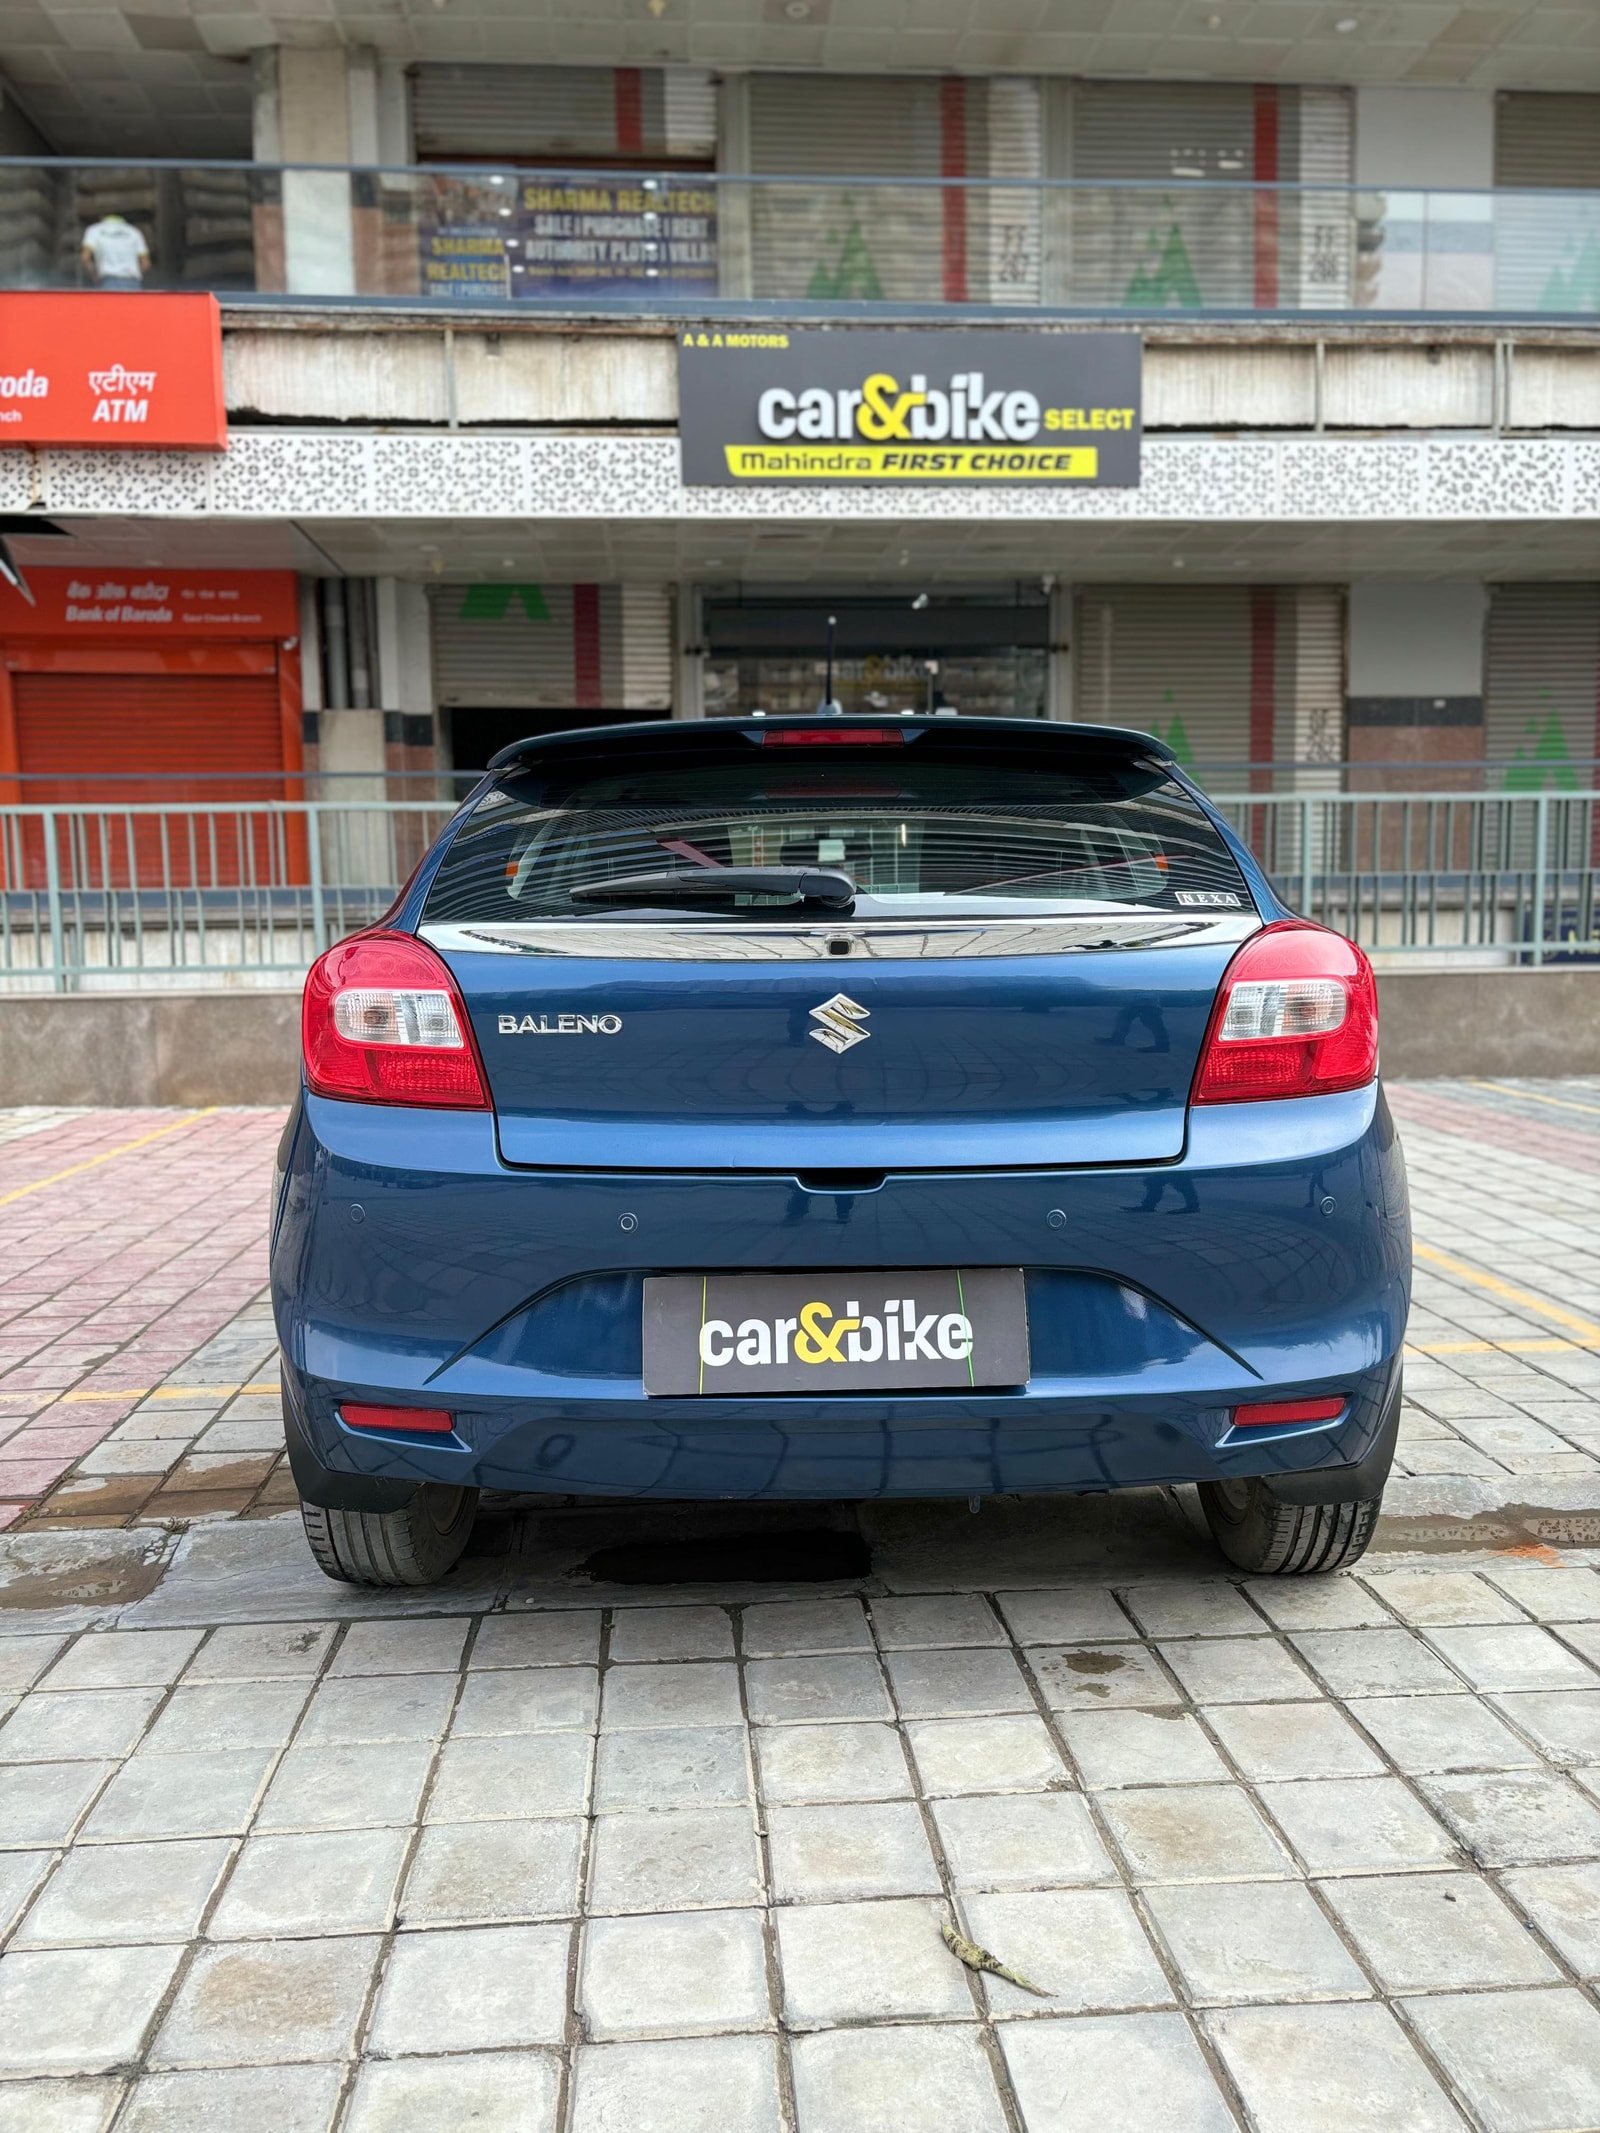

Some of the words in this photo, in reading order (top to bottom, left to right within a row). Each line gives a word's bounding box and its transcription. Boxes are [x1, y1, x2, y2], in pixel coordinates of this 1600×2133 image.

[523, 188, 612, 211] SHARMA
[682, 333, 694, 347] A
[696, 333, 709, 347] &
[712, 333, 723, 347] A
[726, 334, 789, 348] MOTORS
[88, 363, 157, 396] एटीएम
[92, 399, 149, 423] ATM
[757, 372, 1040, 440] car&bike
[1044, 408, 1135, 430] SELECT
[881, 454, 964, 471] FIRST
[969, 454, 1073, 471] CHOICE
[65, 605, 103, 623] Bank
[121, 605, 173, 623] Baroda
[1180, 893, 1237, 905] NEXA
[497, 1013, 623, 1035] BALENO
[699, 1299, 974, 1367] car&bike
